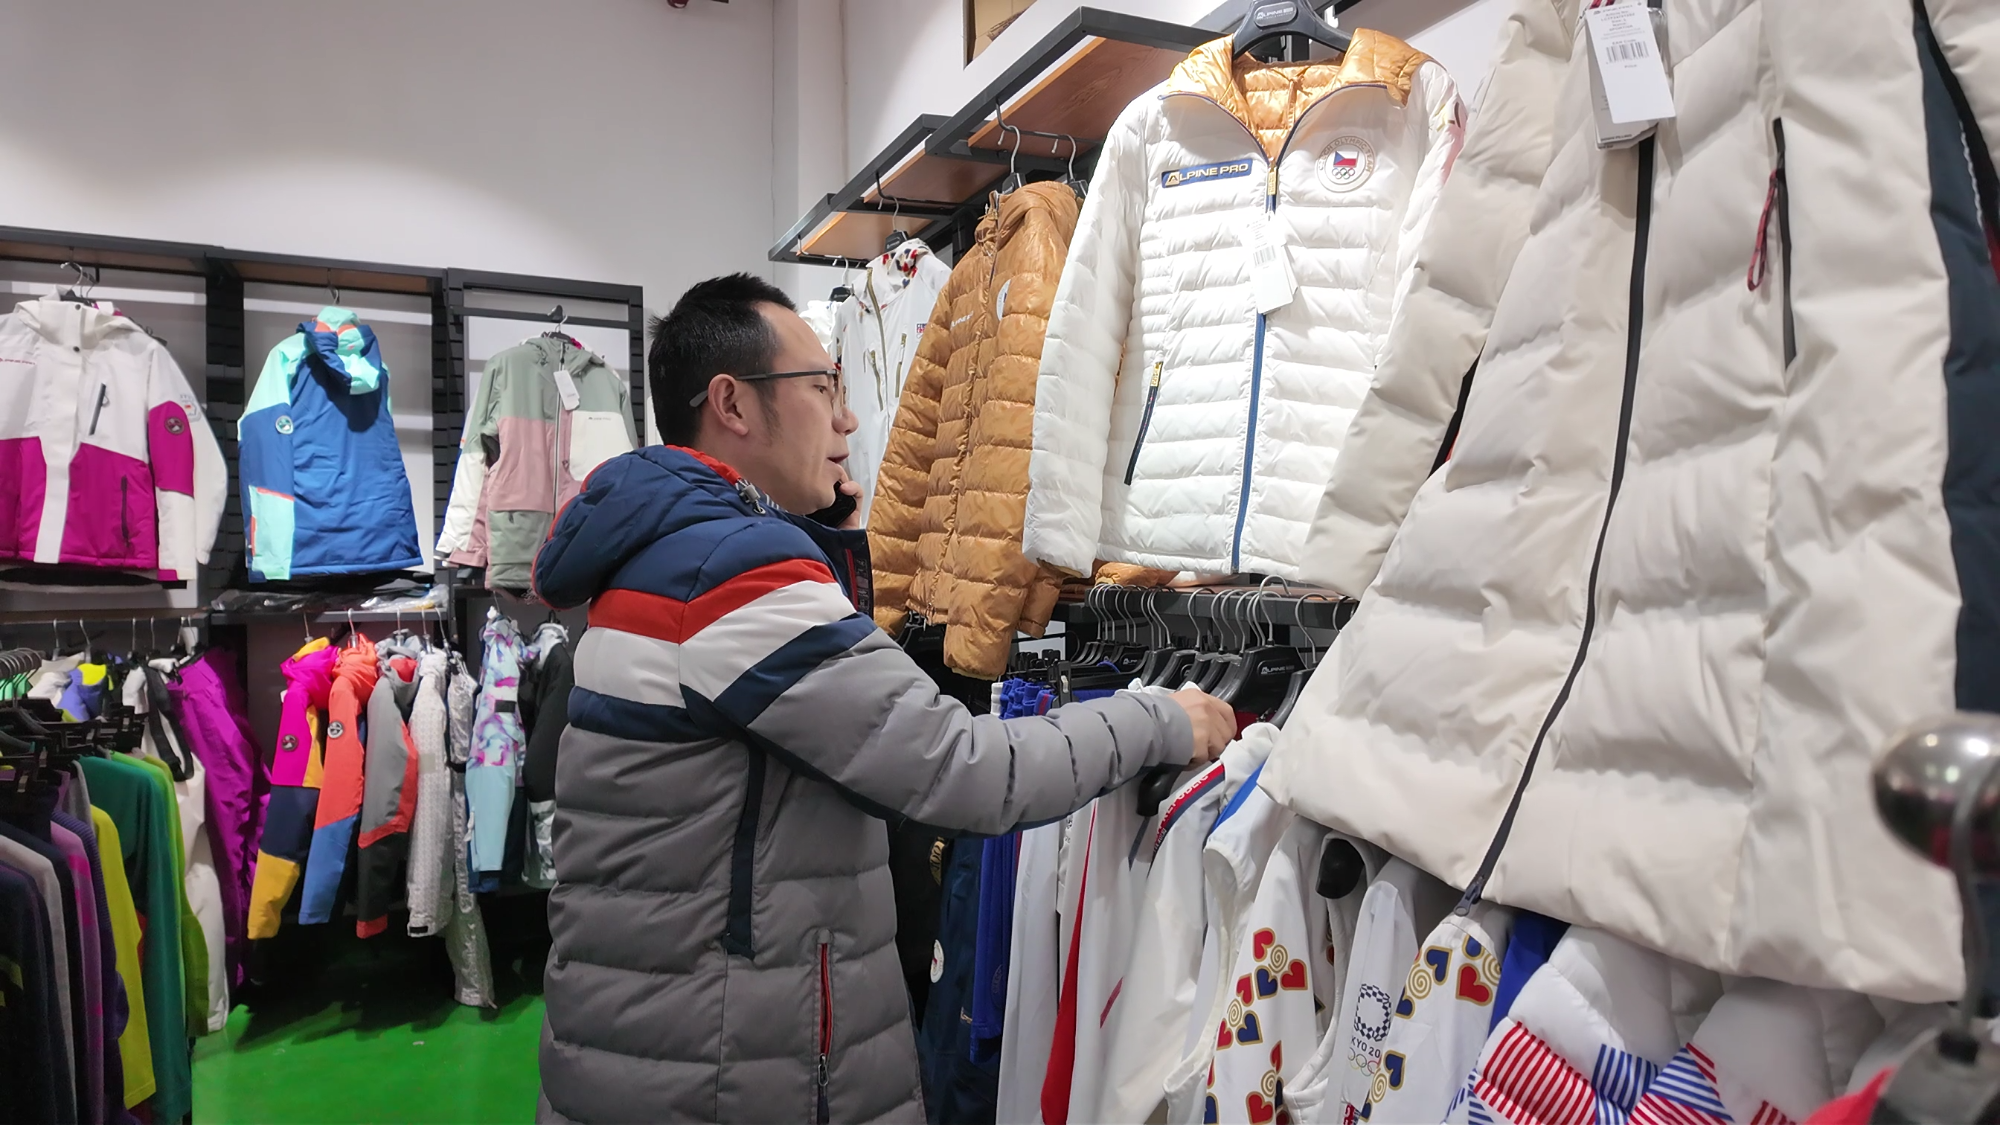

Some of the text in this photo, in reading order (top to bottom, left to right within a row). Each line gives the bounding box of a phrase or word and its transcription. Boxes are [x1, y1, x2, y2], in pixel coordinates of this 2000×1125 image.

[1334, 137, 1367, 151] OLYMPIC
[1165, 163, 1249, 186] ALPINE PRO
[1351, 1036, 1381, 1059] KYO 20
